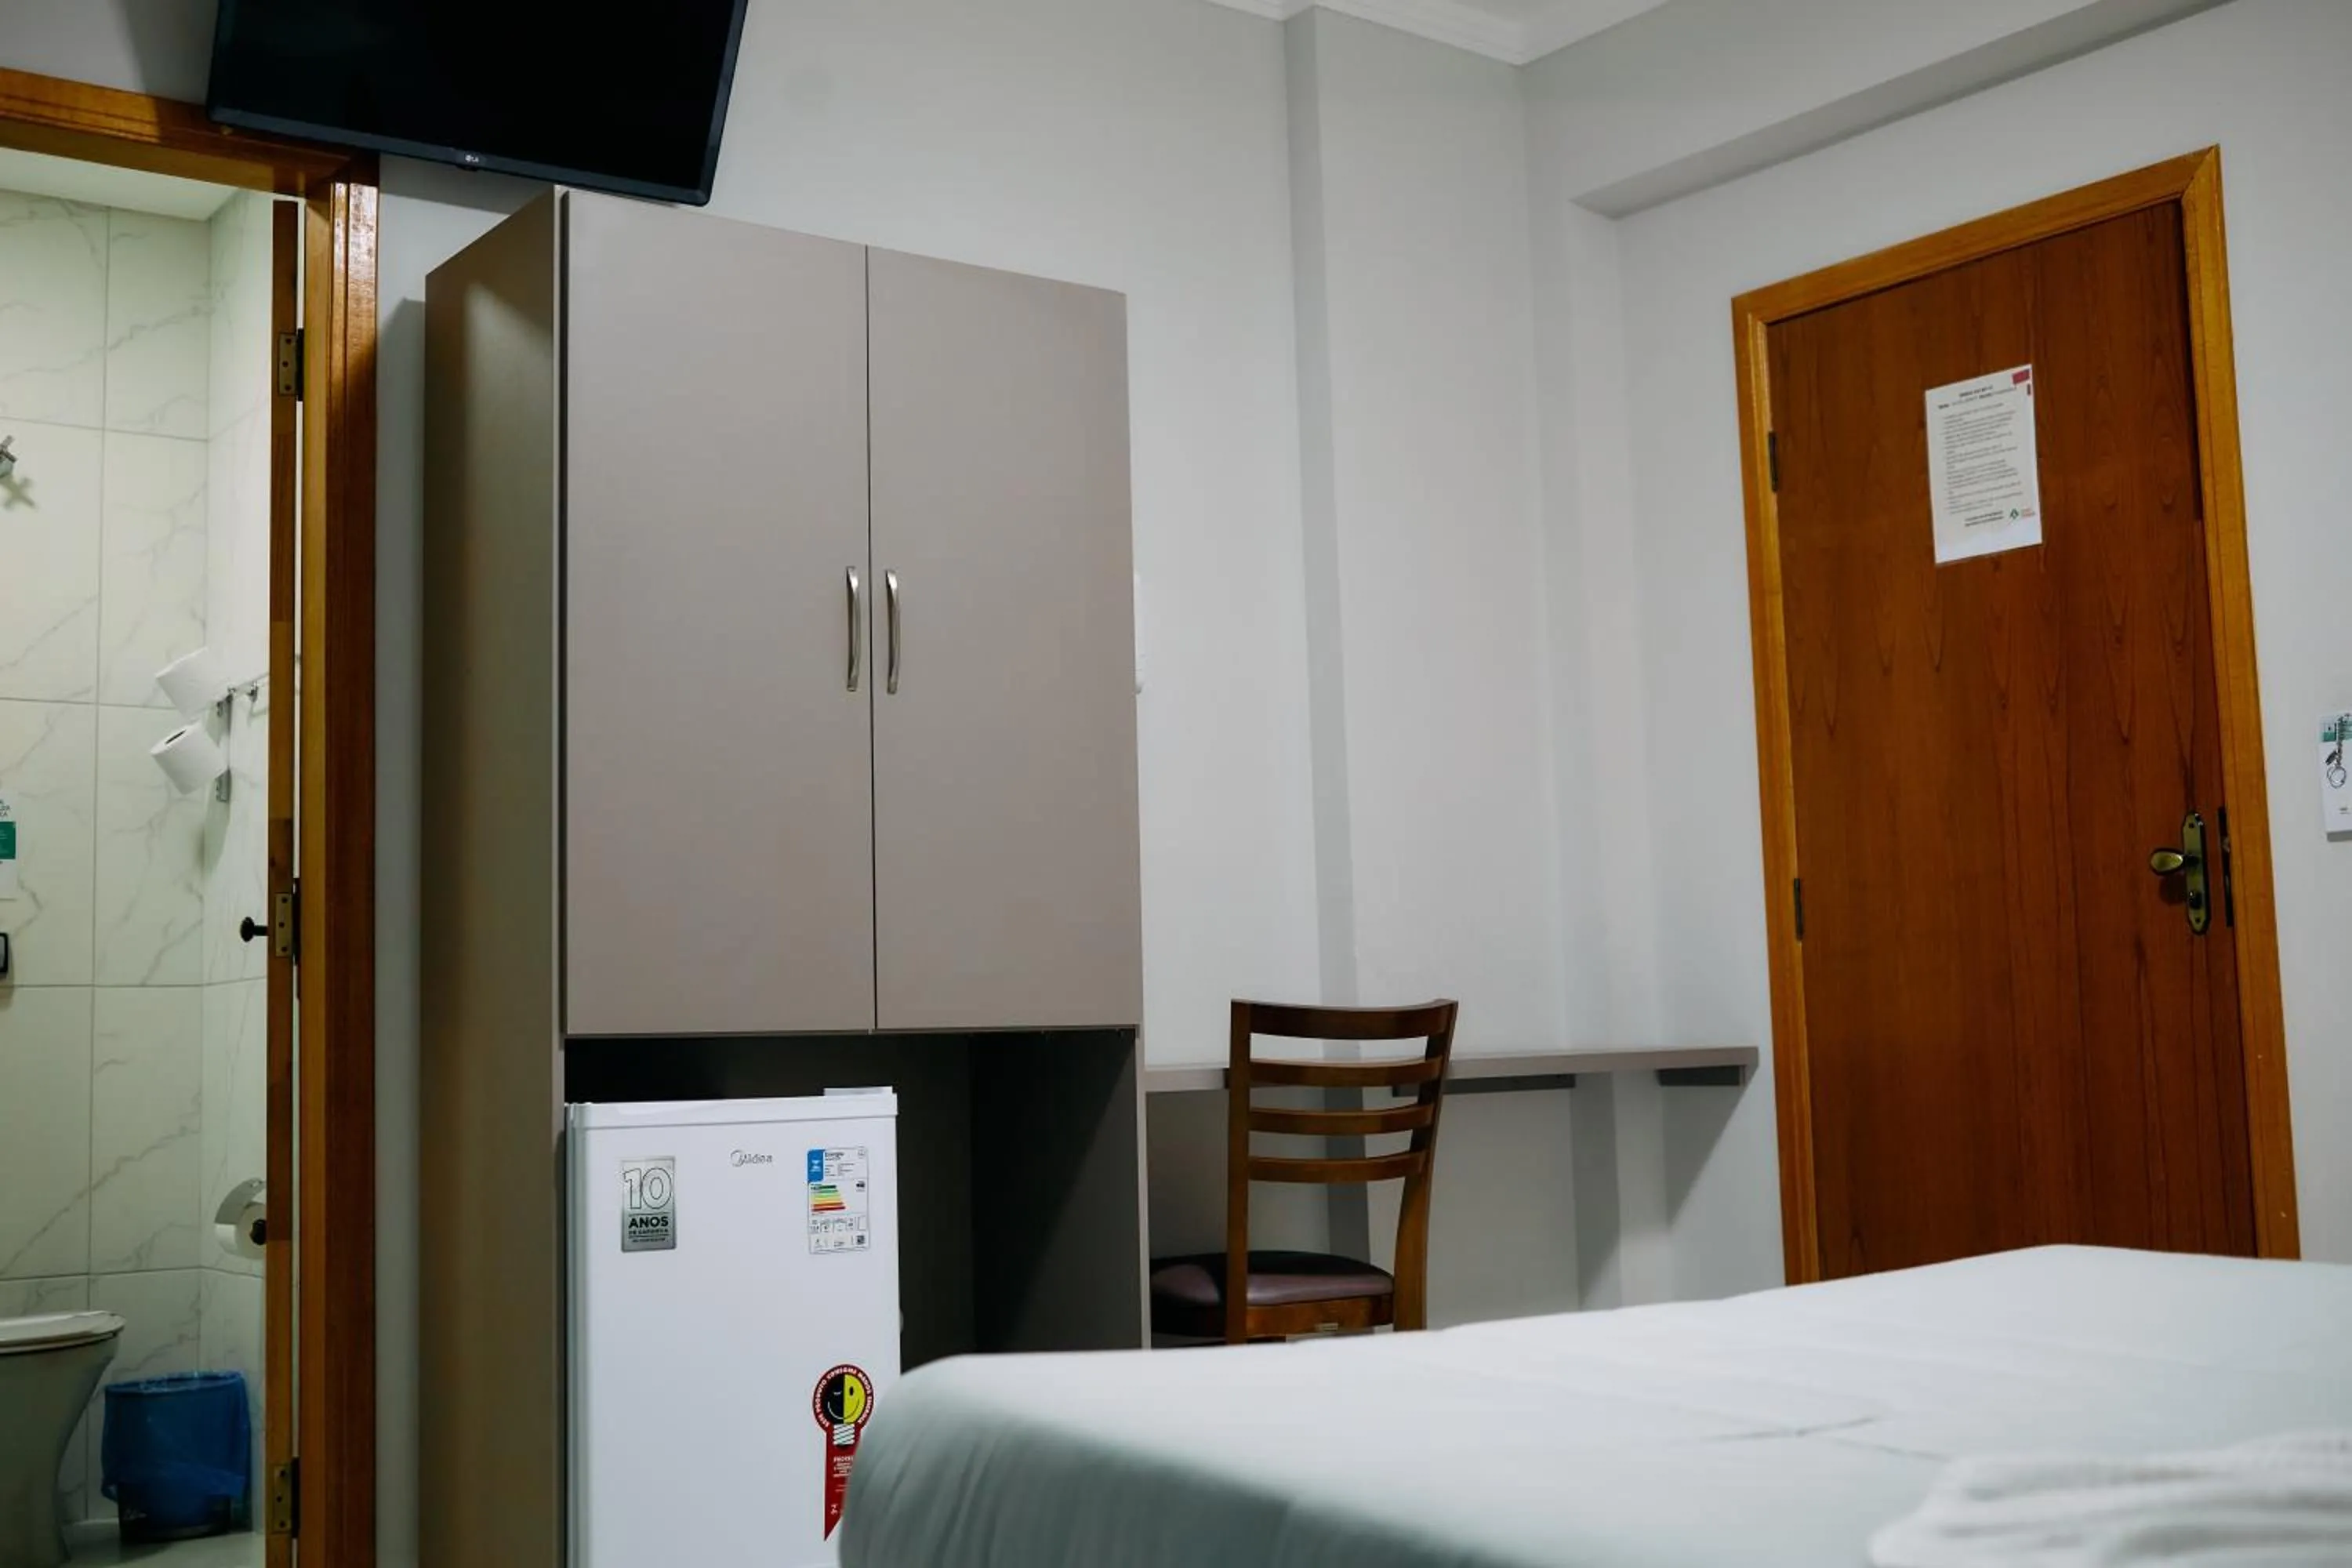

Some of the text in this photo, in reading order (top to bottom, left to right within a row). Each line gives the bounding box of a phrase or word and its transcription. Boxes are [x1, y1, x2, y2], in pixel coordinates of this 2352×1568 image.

[730, 1149, 772, 1167] Midea
[622, 1167, 672, 1210] 10
[628, 1216, 669, 1229] ANOS
